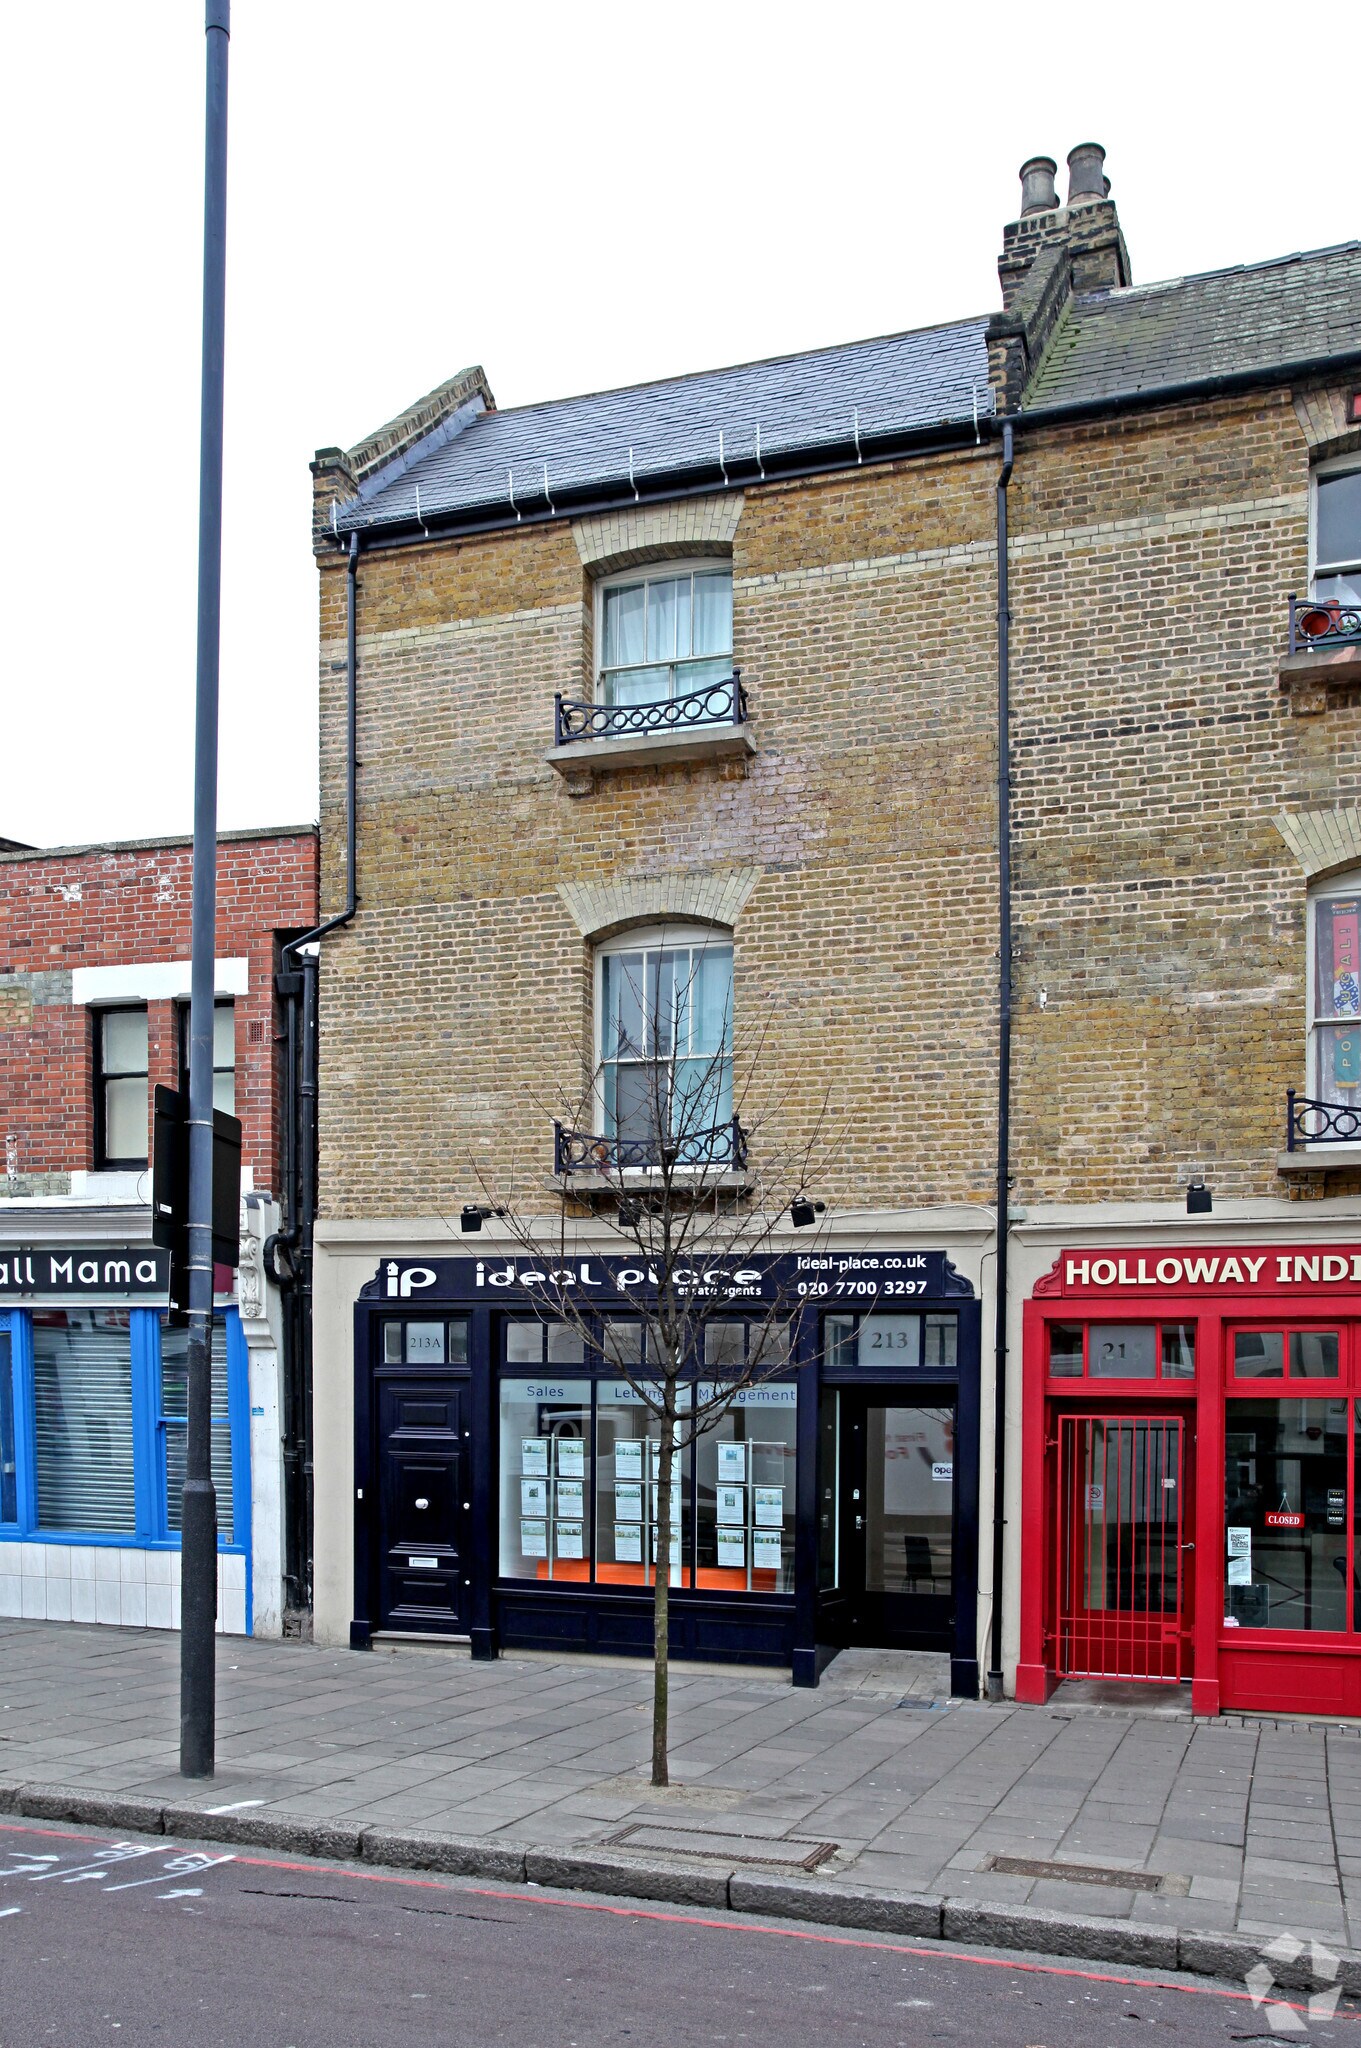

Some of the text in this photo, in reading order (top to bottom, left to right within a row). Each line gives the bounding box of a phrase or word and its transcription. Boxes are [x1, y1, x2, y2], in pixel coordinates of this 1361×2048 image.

[51, 1256, 157, 1283] Mama
[797, 1255, 927, 1273] ideal-place.co.uk
[1066, 1256, 1267, 1285] HOLLOWAY
[386, 1261, 437, 1297] ip
[476, 1262, 602, 1286] ideal
[797, 1280, 927, 1296] 020 7700 3297
[410, 1337, 441, 1348] 213A
[871, 1332, 908, 1349] 213
[527, 1385, 564, 1397] Sales
[699, 1388, 795, 1403] Magement
[934, 1467, 952, 1475] ope
[1268, 1515, 1300, 1525] CLOSED
